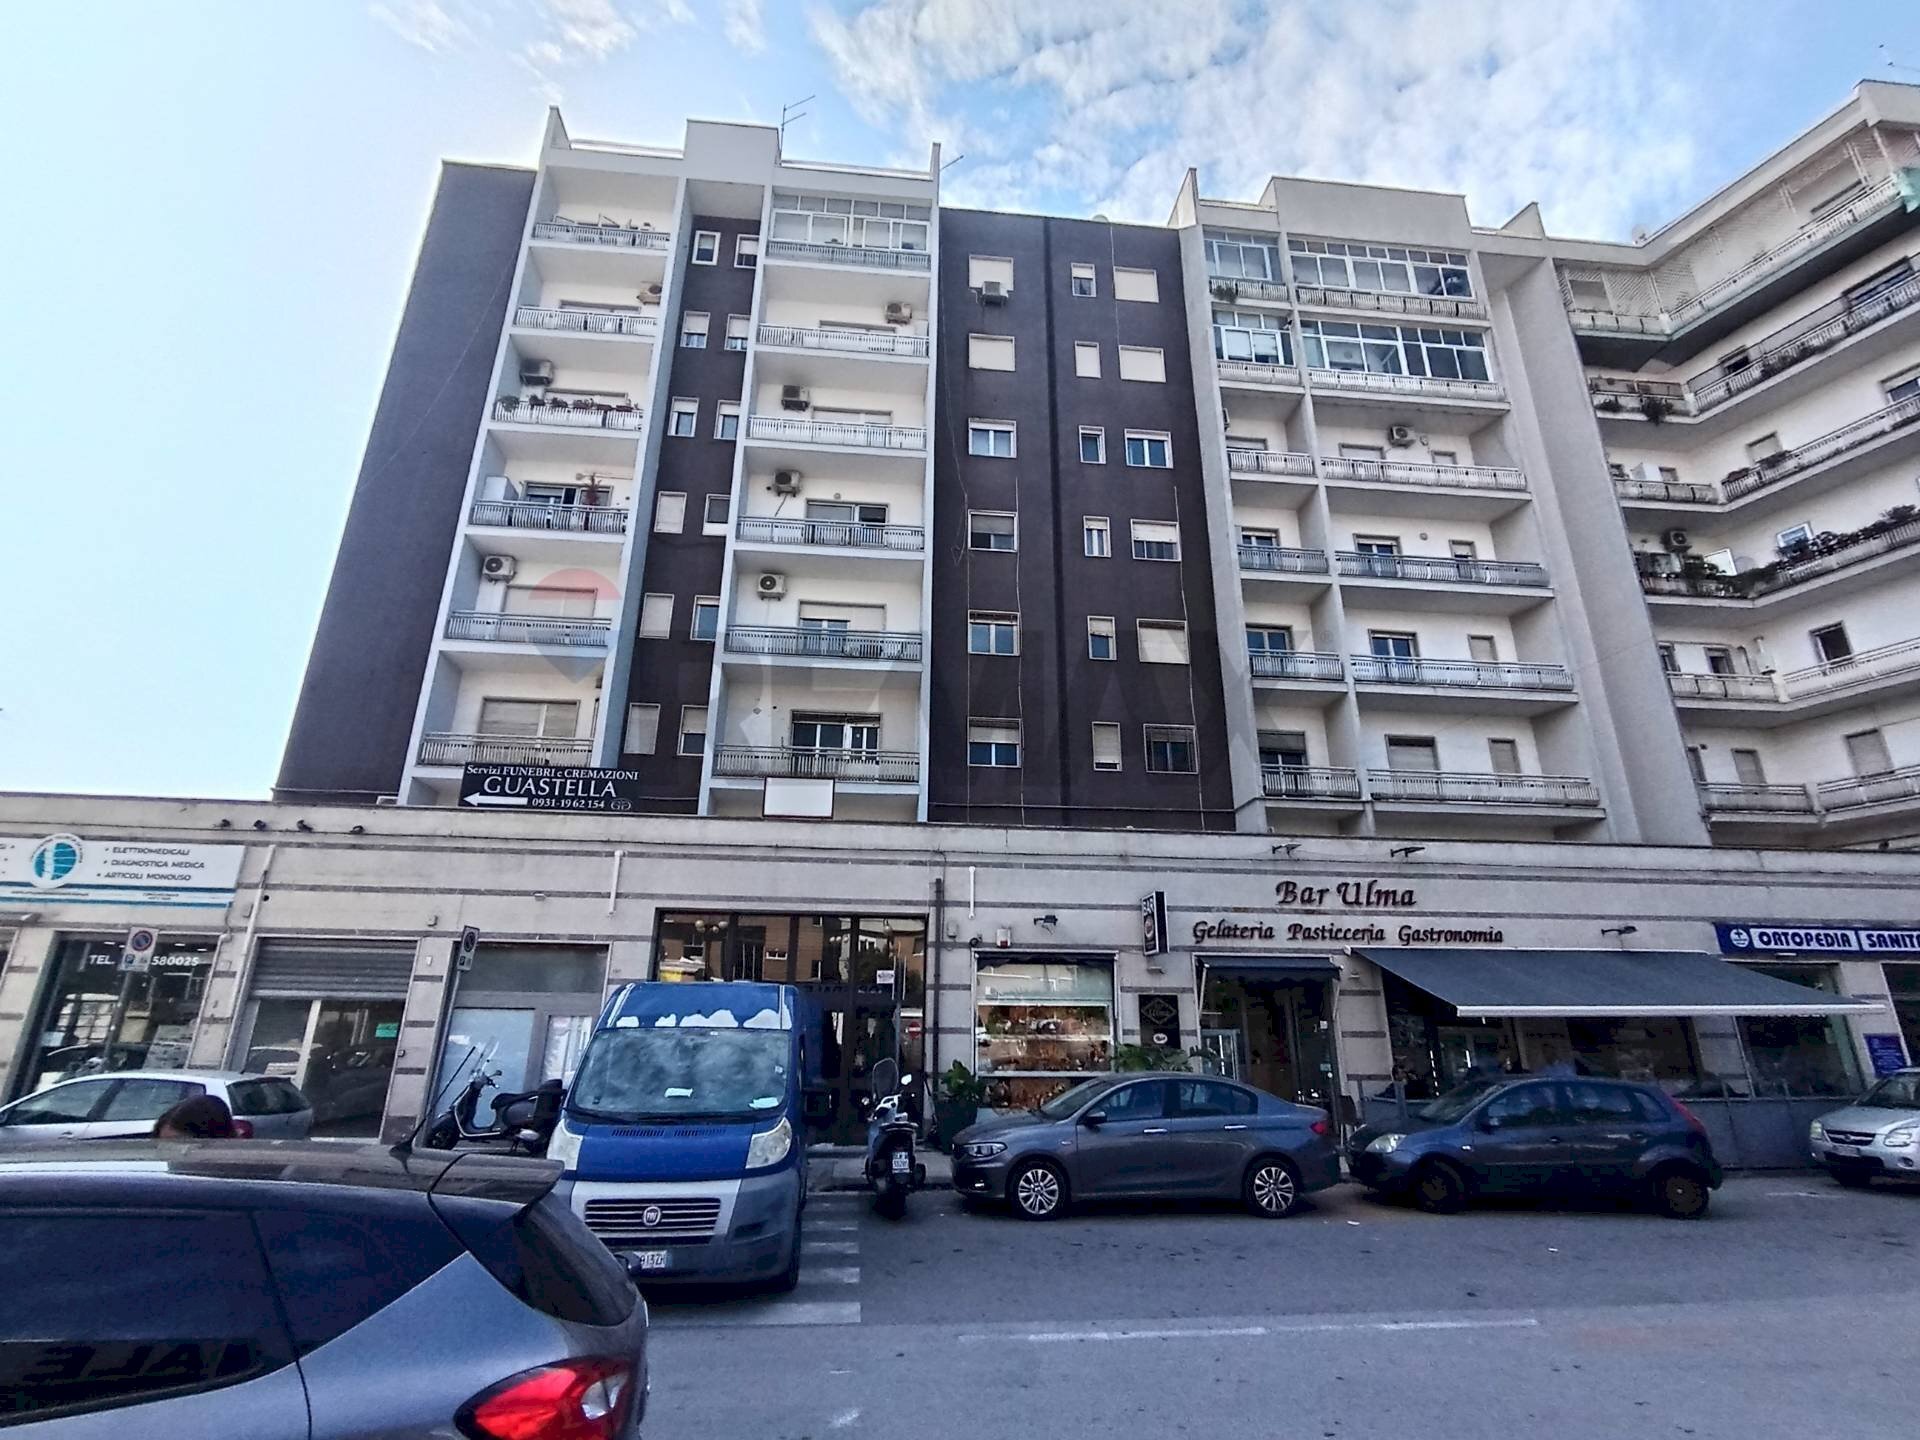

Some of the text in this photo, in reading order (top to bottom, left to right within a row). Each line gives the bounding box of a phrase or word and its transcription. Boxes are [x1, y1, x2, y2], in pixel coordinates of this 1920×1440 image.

[467, 764, 501, 776] Servizi
[502, 766, 556, 778] FUNEBRI
[564, 769, 639, 781] CREMAZIONI
[483, 775, 617, 798] GUASTELLA
[112, 846, 191, 856] ELETTROMEDICALI
[111, 859, 206, 869] DIAGNOSTICA MEDICA
[104, 871, 192, 881] ARTICOLI MONOUSO
[1275, 879, 1417, 907] Bar Ulma
[1193, 918, 1504, 947] Gelateria Pasticceria Gastronomia
[1758, 930, 1853, 948] ORTOPEDIA
[89, 955, 116, 966] TEL.
